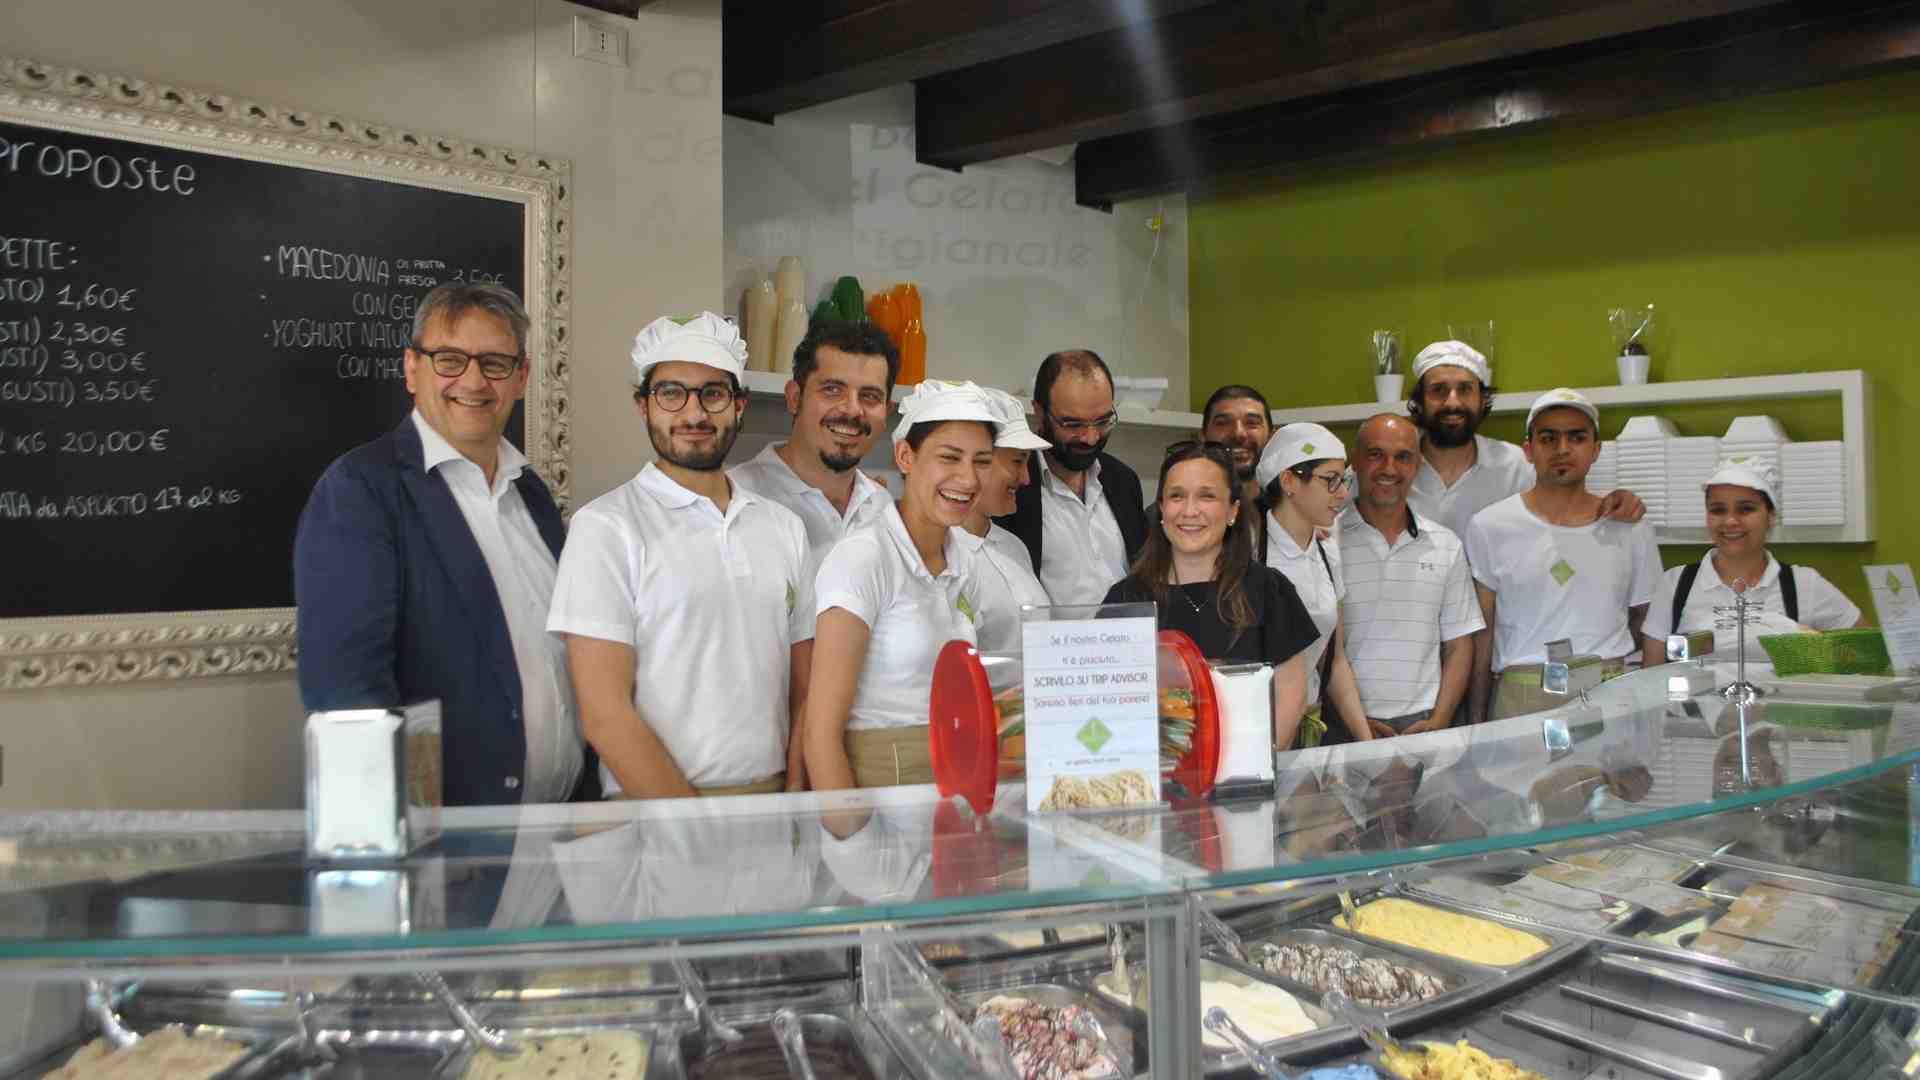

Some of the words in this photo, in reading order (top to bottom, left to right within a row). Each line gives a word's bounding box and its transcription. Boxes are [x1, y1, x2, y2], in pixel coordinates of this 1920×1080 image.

[278, 245, 390, 284] MACEDONIA
[272, 318, 356, 349] YOGHURT
[60, 350, 146, 373] 3,00€
